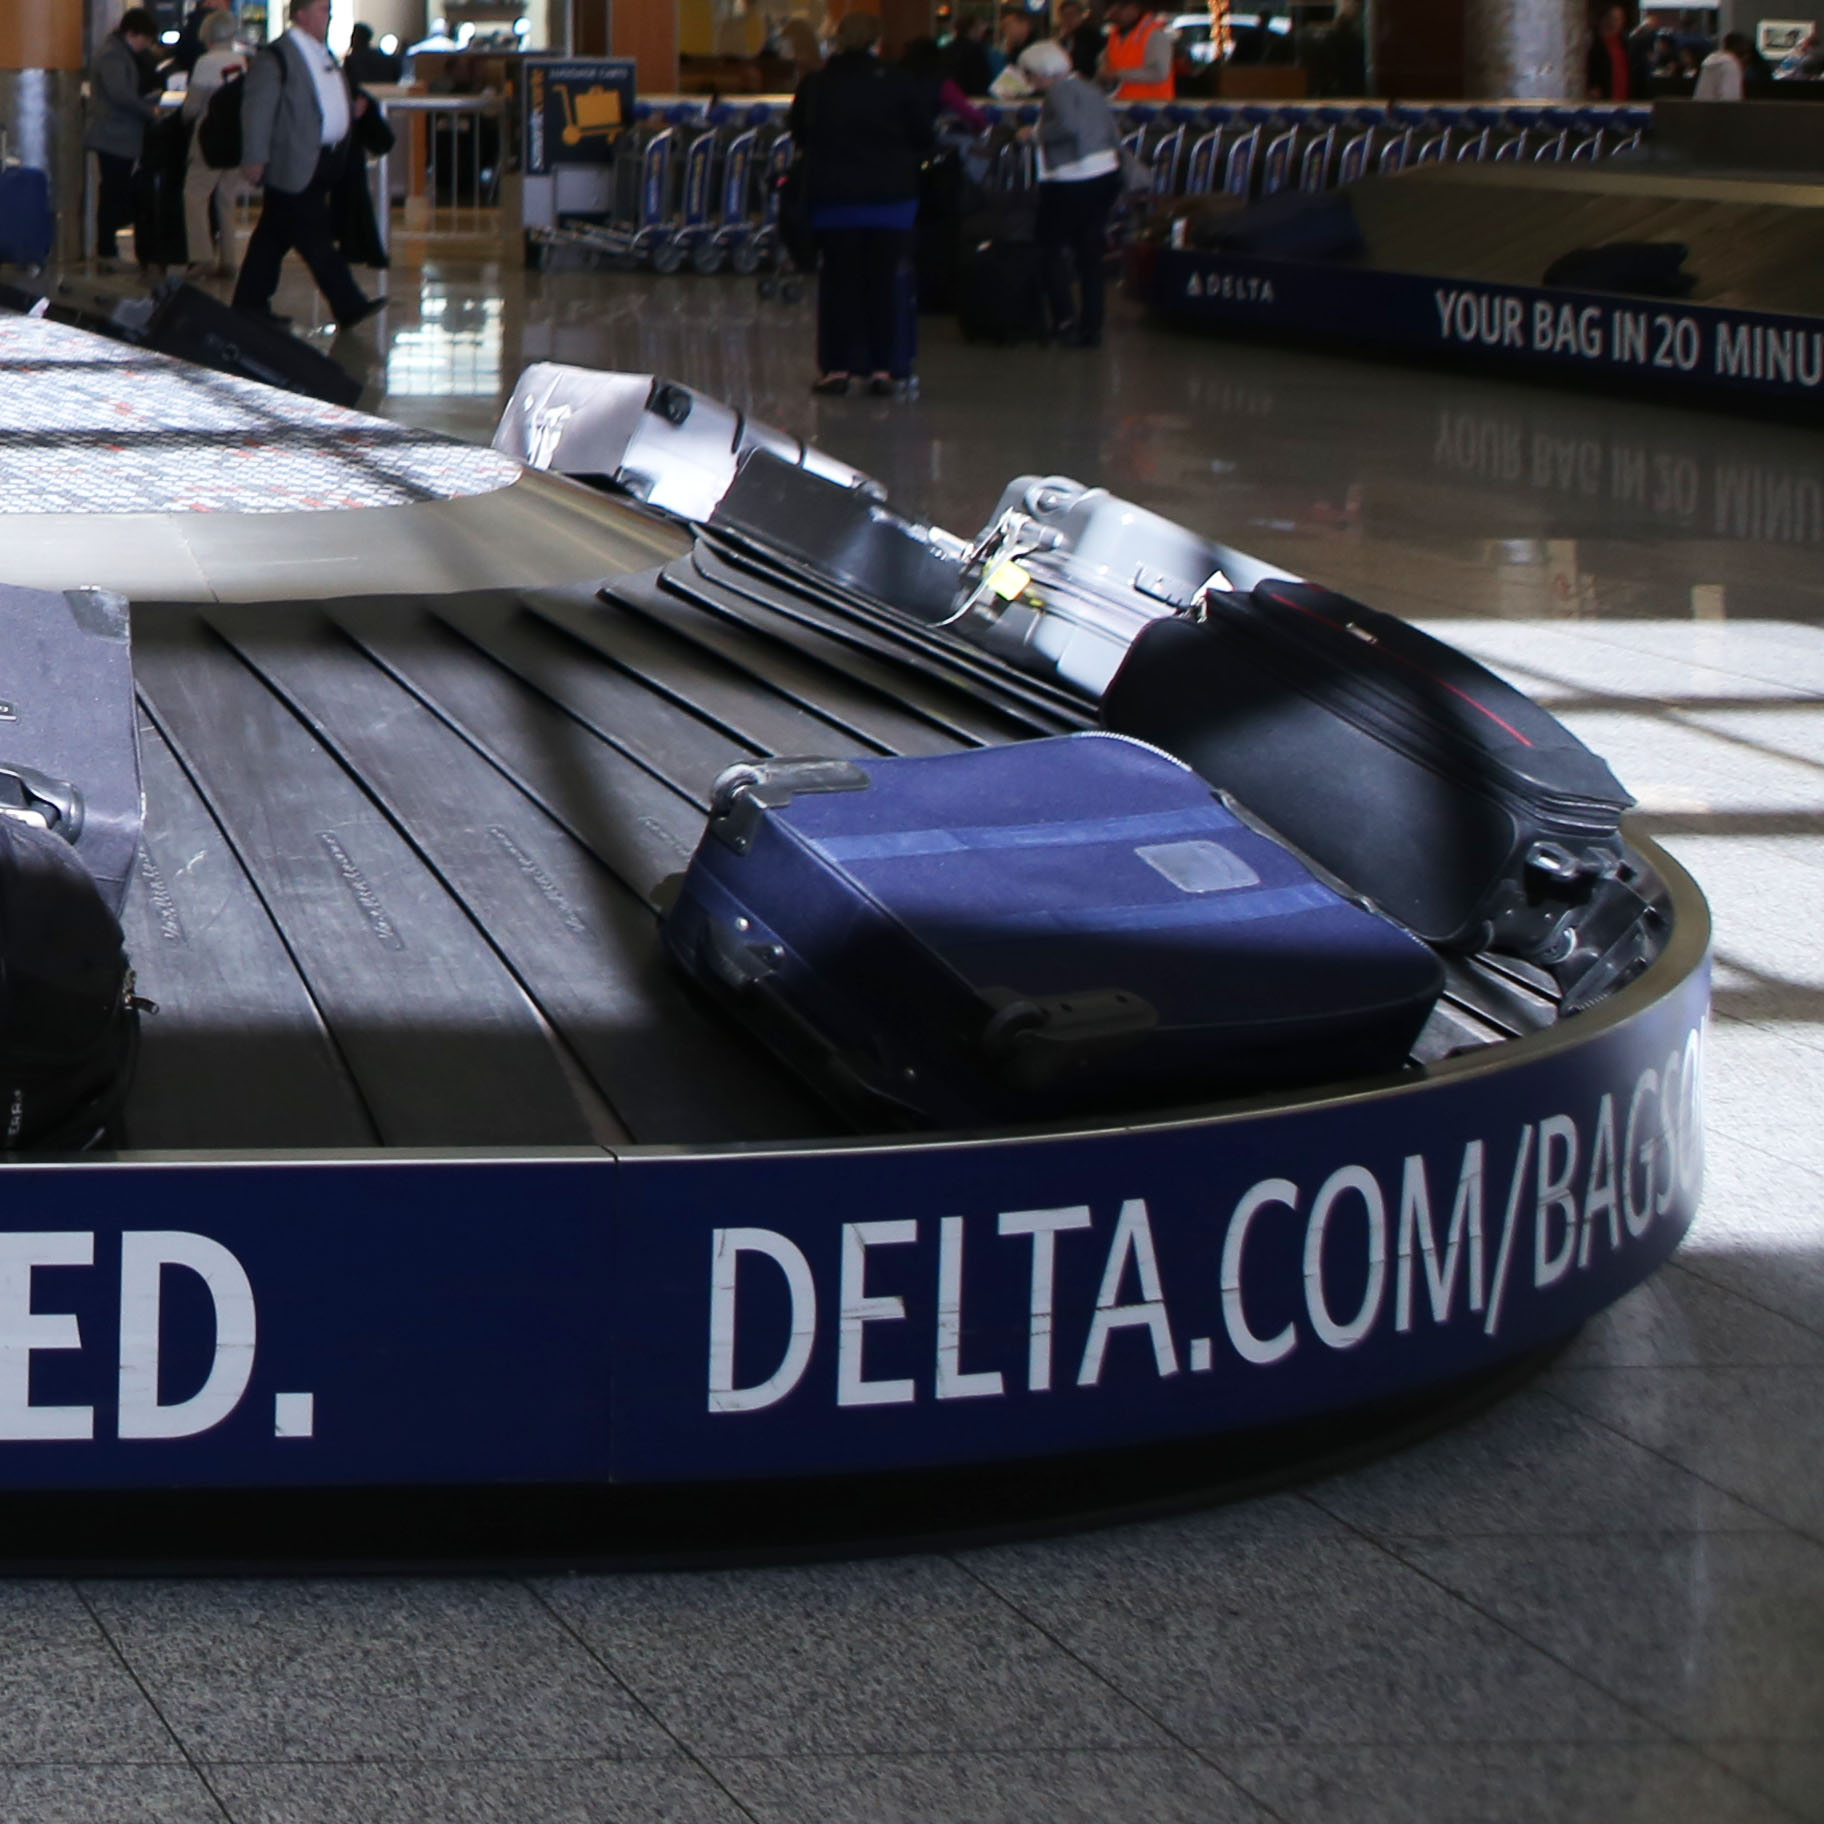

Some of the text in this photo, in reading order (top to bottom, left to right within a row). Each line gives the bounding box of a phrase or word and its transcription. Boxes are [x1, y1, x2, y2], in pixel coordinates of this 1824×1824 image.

[1206, 273, 1275, 302] DELTA
[1434, 290, 1824, 387] YOUR BAG IN 20 MINU
